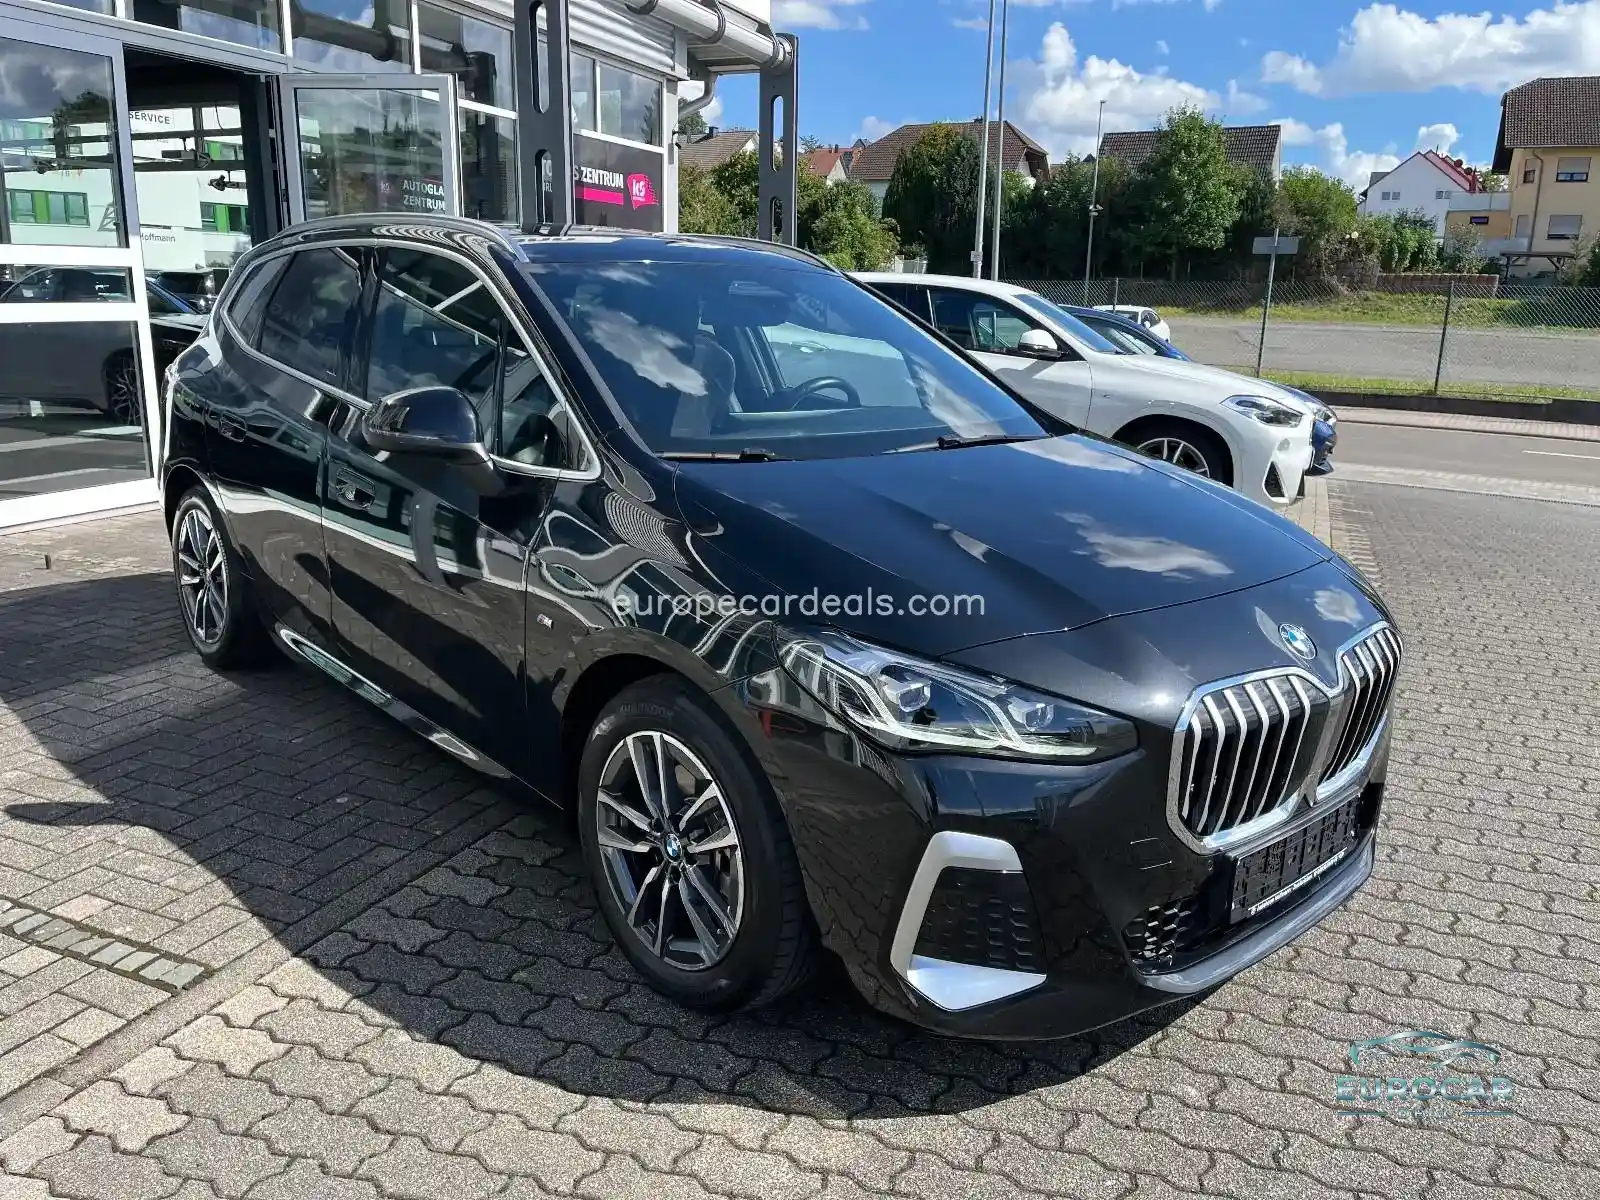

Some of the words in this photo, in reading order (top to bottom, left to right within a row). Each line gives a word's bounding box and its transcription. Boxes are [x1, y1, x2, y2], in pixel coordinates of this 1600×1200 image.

[128, 111, 171, 125] SERVICE
[581, 166, 624, 189] ZENTRUM
[403, 179, 445, 196] AUTOGLA
[403, 194, 446, 211] ZENTRUM
